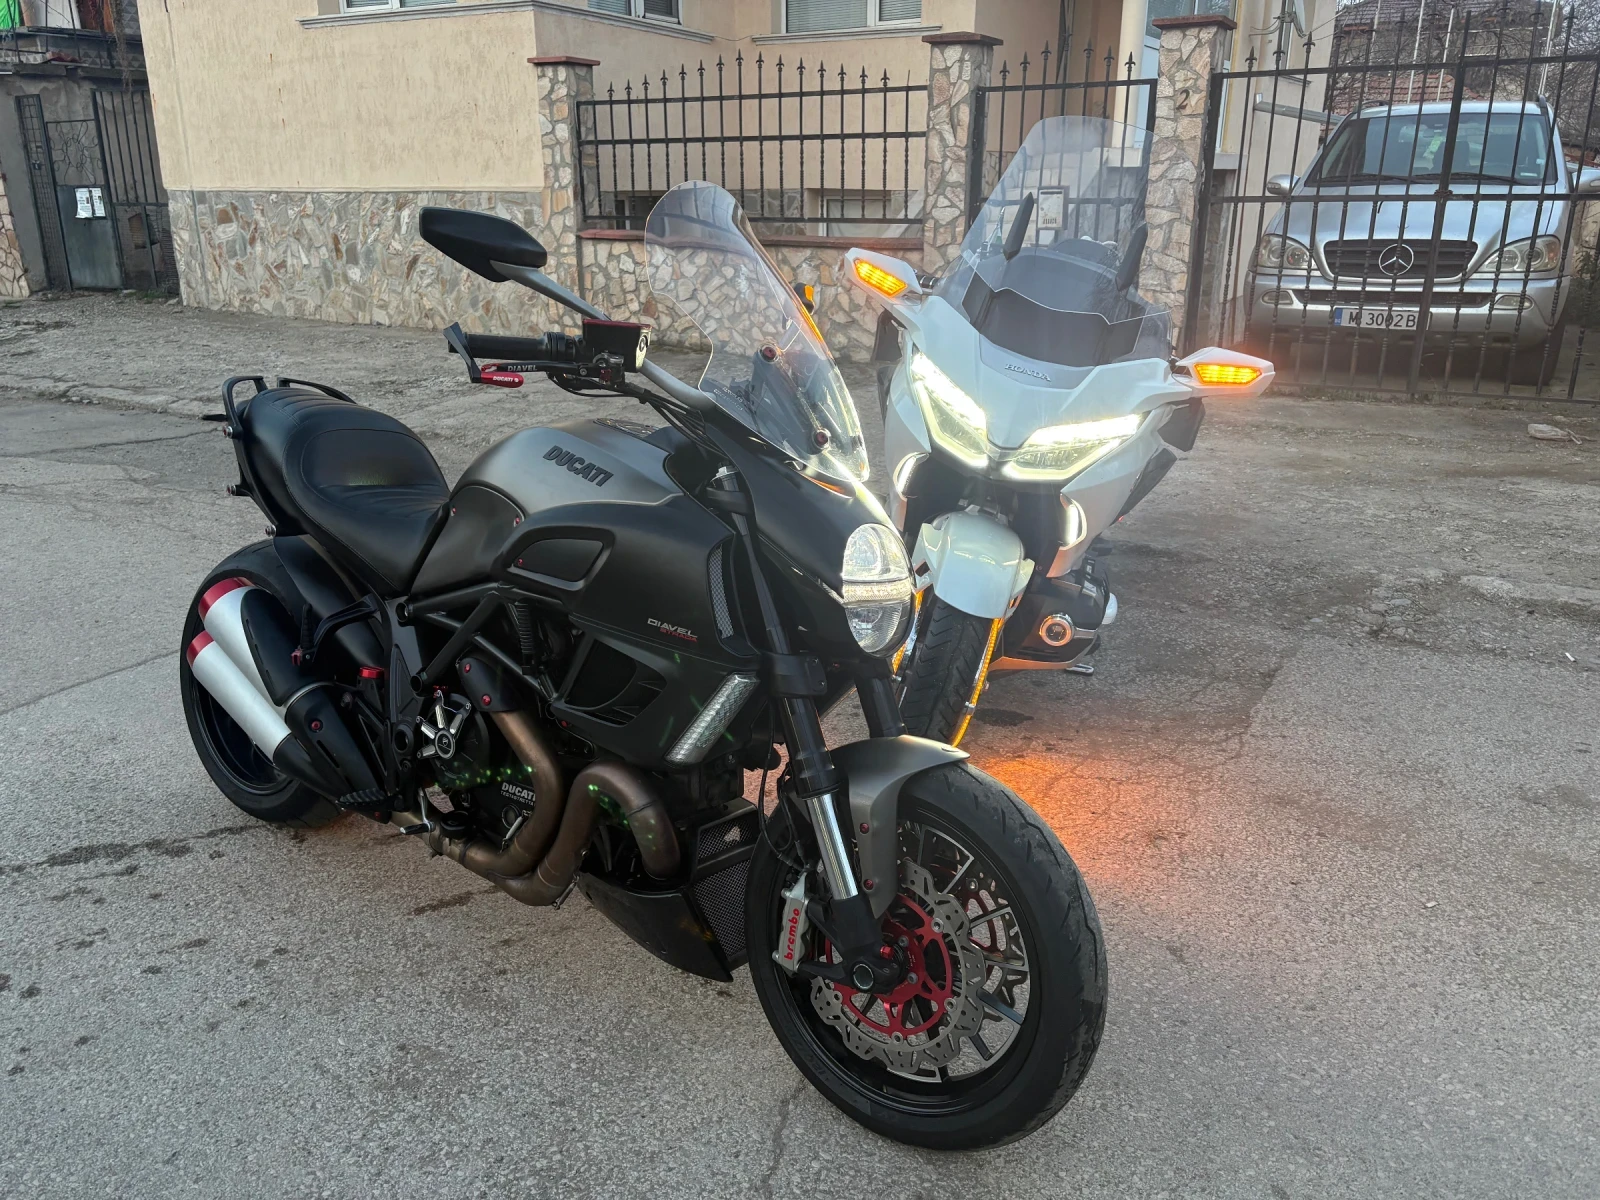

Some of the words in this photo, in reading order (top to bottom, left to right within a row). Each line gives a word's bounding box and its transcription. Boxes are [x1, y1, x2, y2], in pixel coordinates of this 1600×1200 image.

[1176, 89, 1190, 110] 2
[507, 364, 538, 372] DIAVEL
[1004, 363, 1052, 382] HONDA
[492, 375, 514, 383] DUCATI
[542, 444, 615, 488] DUCATI
[647, 617, 698, 638] DIAVEL
[501, 782, 536, 802] DUCATI
[783, 907, 801, 961] brembo
